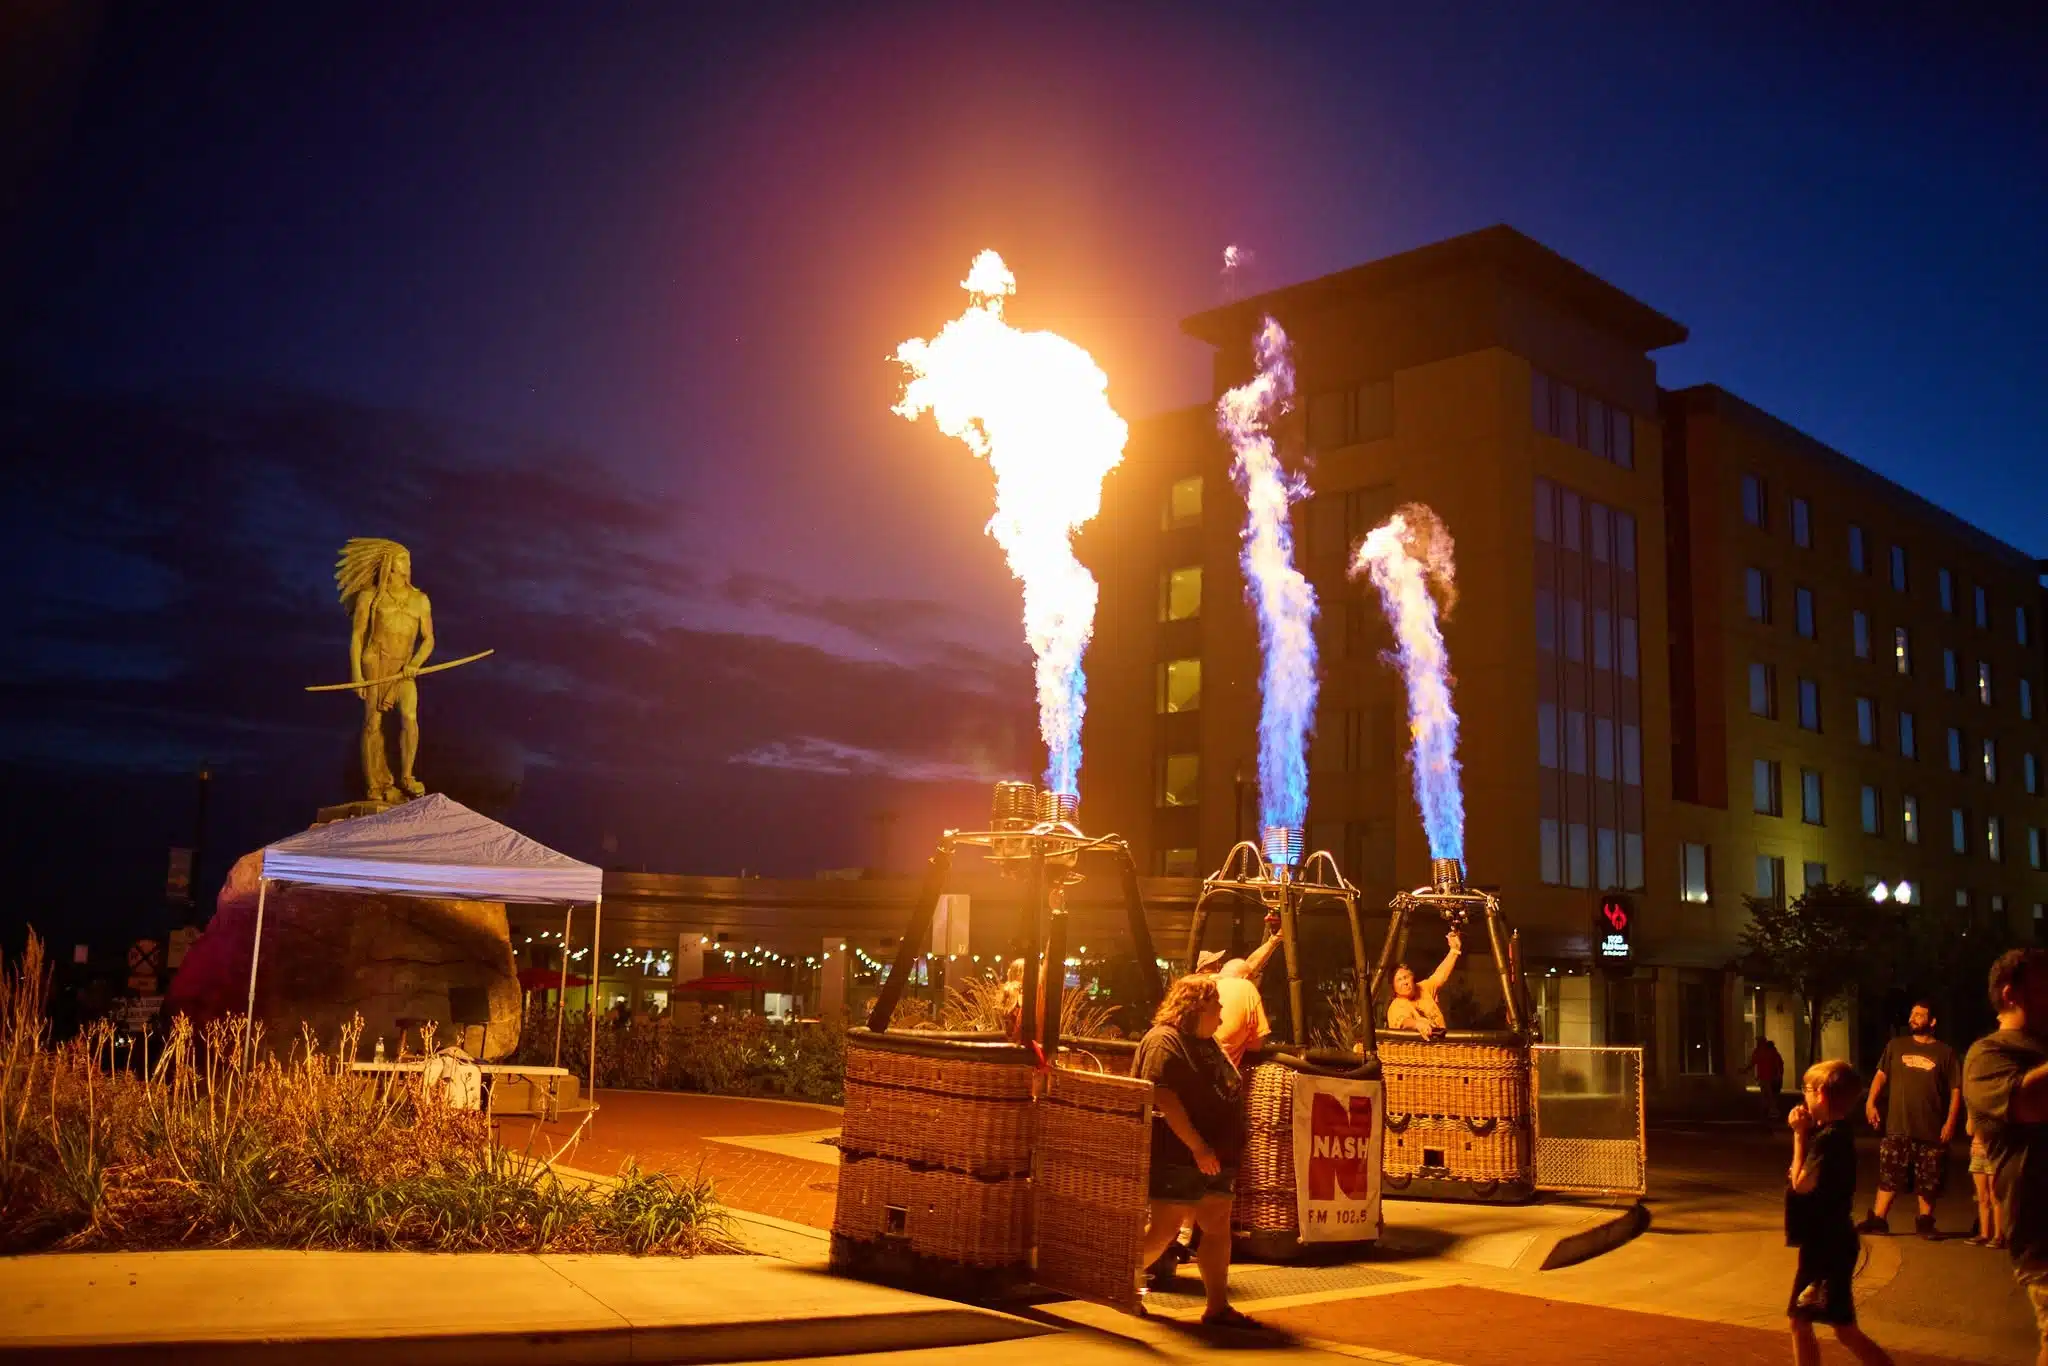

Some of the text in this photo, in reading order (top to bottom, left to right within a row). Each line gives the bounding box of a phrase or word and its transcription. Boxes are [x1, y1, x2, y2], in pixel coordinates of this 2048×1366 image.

[1313, 1135, 1369, 1159] NASH
[1308, 1209, 1367, 1224] FM 102.5
